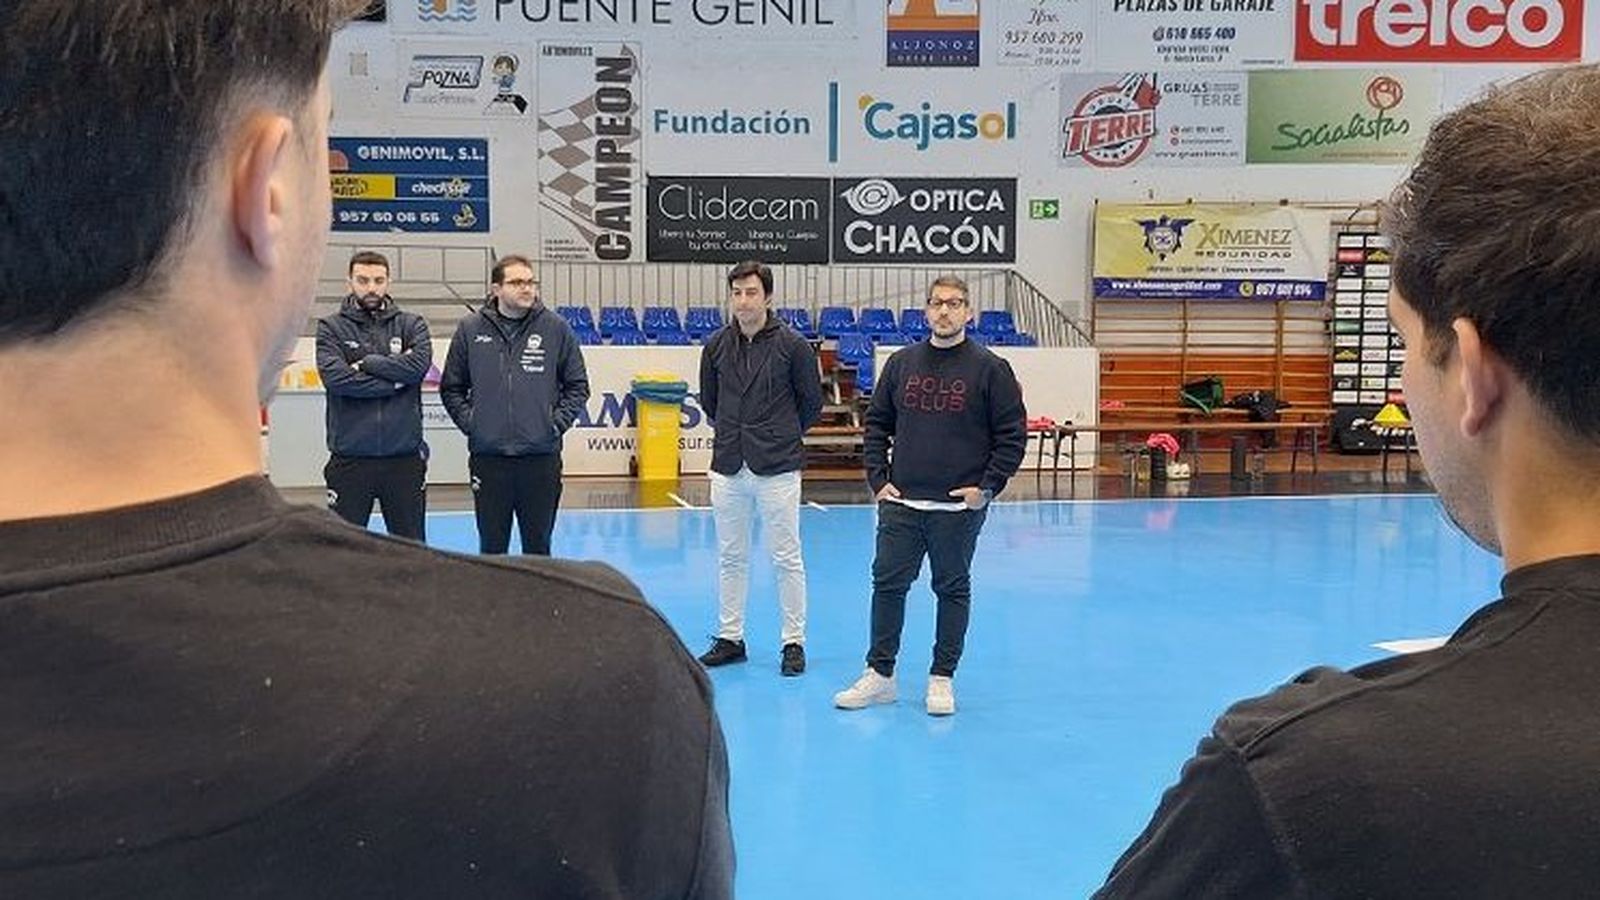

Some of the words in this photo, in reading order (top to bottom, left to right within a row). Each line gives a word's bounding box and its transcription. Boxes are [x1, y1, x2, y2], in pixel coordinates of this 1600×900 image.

[495, 0, 674, 23] PUENTE
[692, 0, 834, 25] GENIL
[891, 40, 975, 50] ALJONOZ
[1163, 82, 1209, 94] GRUAS
[1191, 94, 1242, 107] TERRE
[653, 107, 812, 135] Fundación
[863, 101, 1017, 151] Cajasol
[1065, 110, 1154, 153] TERRE
[1271, 110, 1410, 151] Socialistas
[357, 146, 455, 161] GENIMOVIL,
[458, 147, 485, 161] S.L.
[594, 57, 633, 260] CAMPEON
[658, 183, 819, 221] Clidecem
[909, 189, 1006, 212] OPTICA
[843, 216, 1006, 255] CHACÓN
[1195, 222, 1293, 250] XIMENEZ
[1194, 250, 1292, 259] SEGURIDAD
[905, 374, 967, 395] POLO
[903, 392, 966, 412] CLUB
